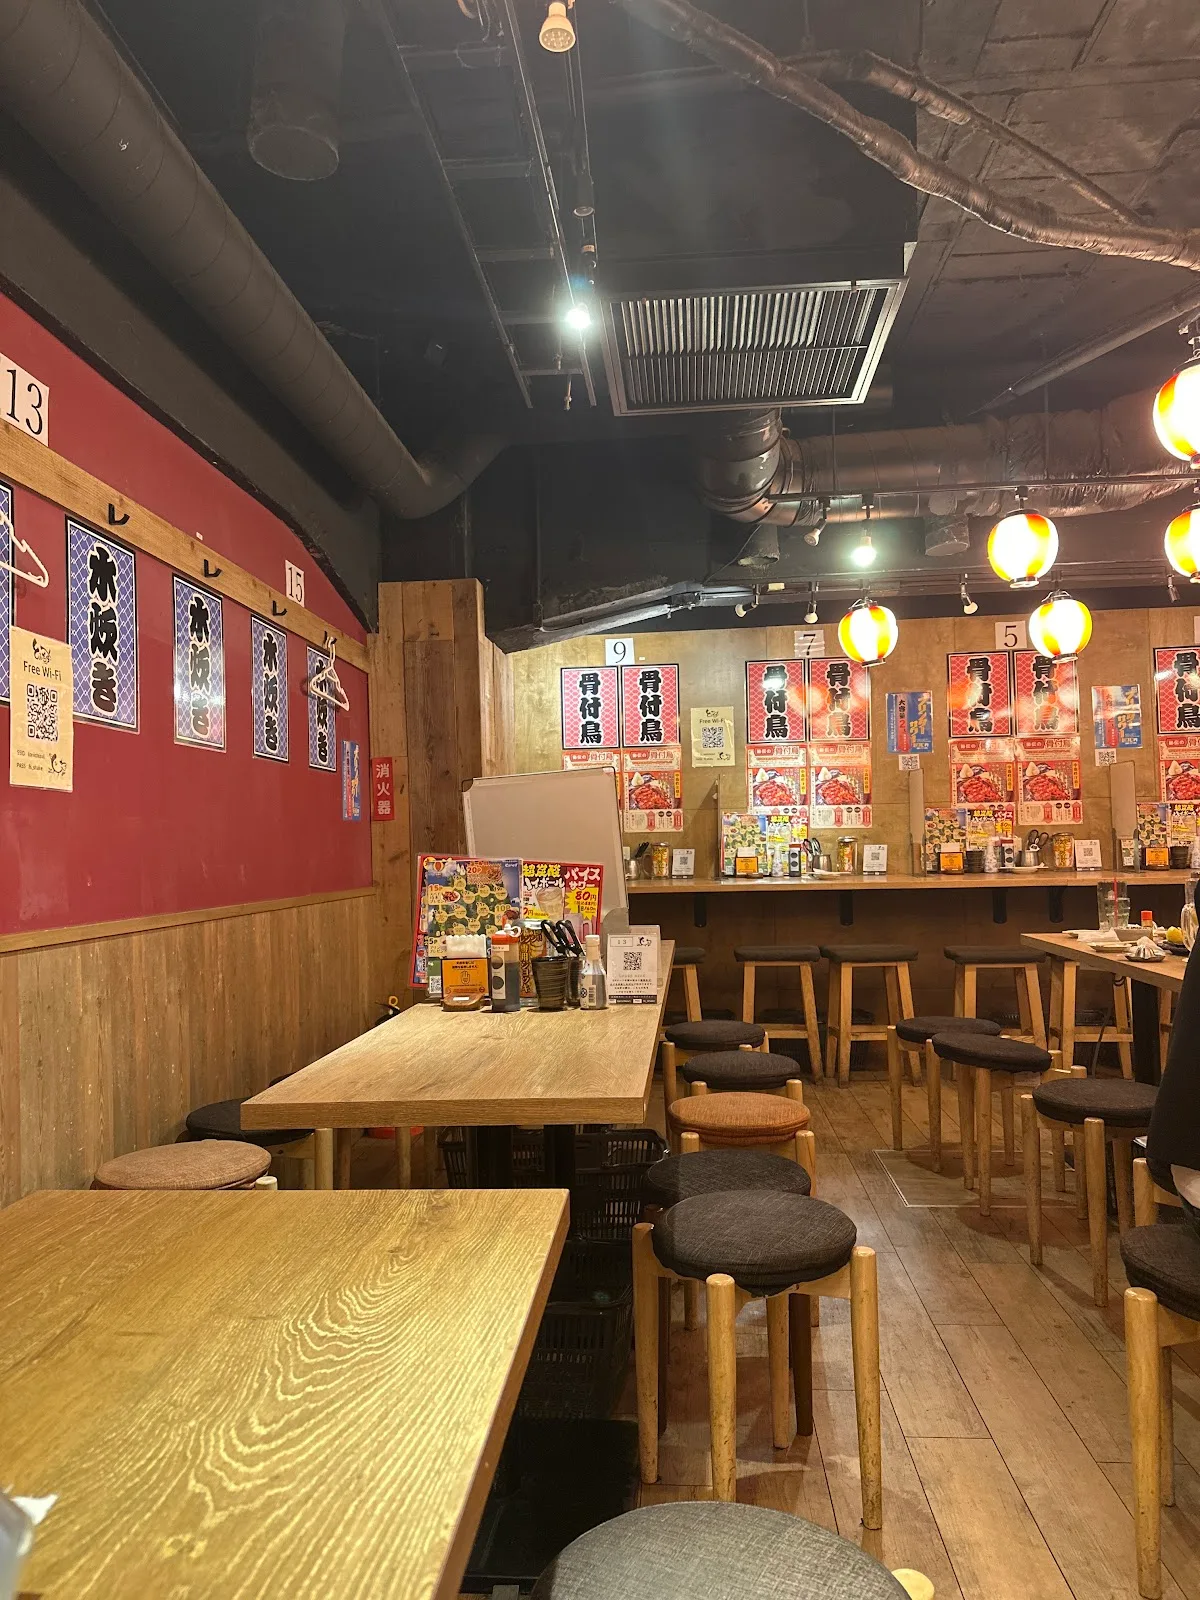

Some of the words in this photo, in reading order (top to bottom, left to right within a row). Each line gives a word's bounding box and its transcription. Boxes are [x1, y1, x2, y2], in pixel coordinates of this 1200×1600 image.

[6, 369, 43, 435] 13
[287, 567, 304, 602] 15
[89, 543, 119, 714] 水炊き
[613, 641, 627, 663] 9
[802, 634, 816, 656] 7
[1004, 625, 1018, 648] 5
[24, 661, 41, 676] Free
[42, 667, 62, 682] Wi-Fi
[189, 594, 211, 737] 水炊き
[263, 632, 279, 752] 水炊き
[763, 664, 788, 738] 骨付鳥
[827, 662, 851, 737] 骨付鳥
[967, 657, 992, 732] 骨付鳥
[1032, 655, 1058, 731] 骨付鳥
[1174, 652, 1200, 729] 骨付鳥
[579, 672, 602, 744] 骨付鳥
[639, 669, 662, 743] 骨付鳥
[376, 763, 392, 815] 消火器
[564, 867, 600, 881] バイス
[569, 881, 595, 890] サワー
